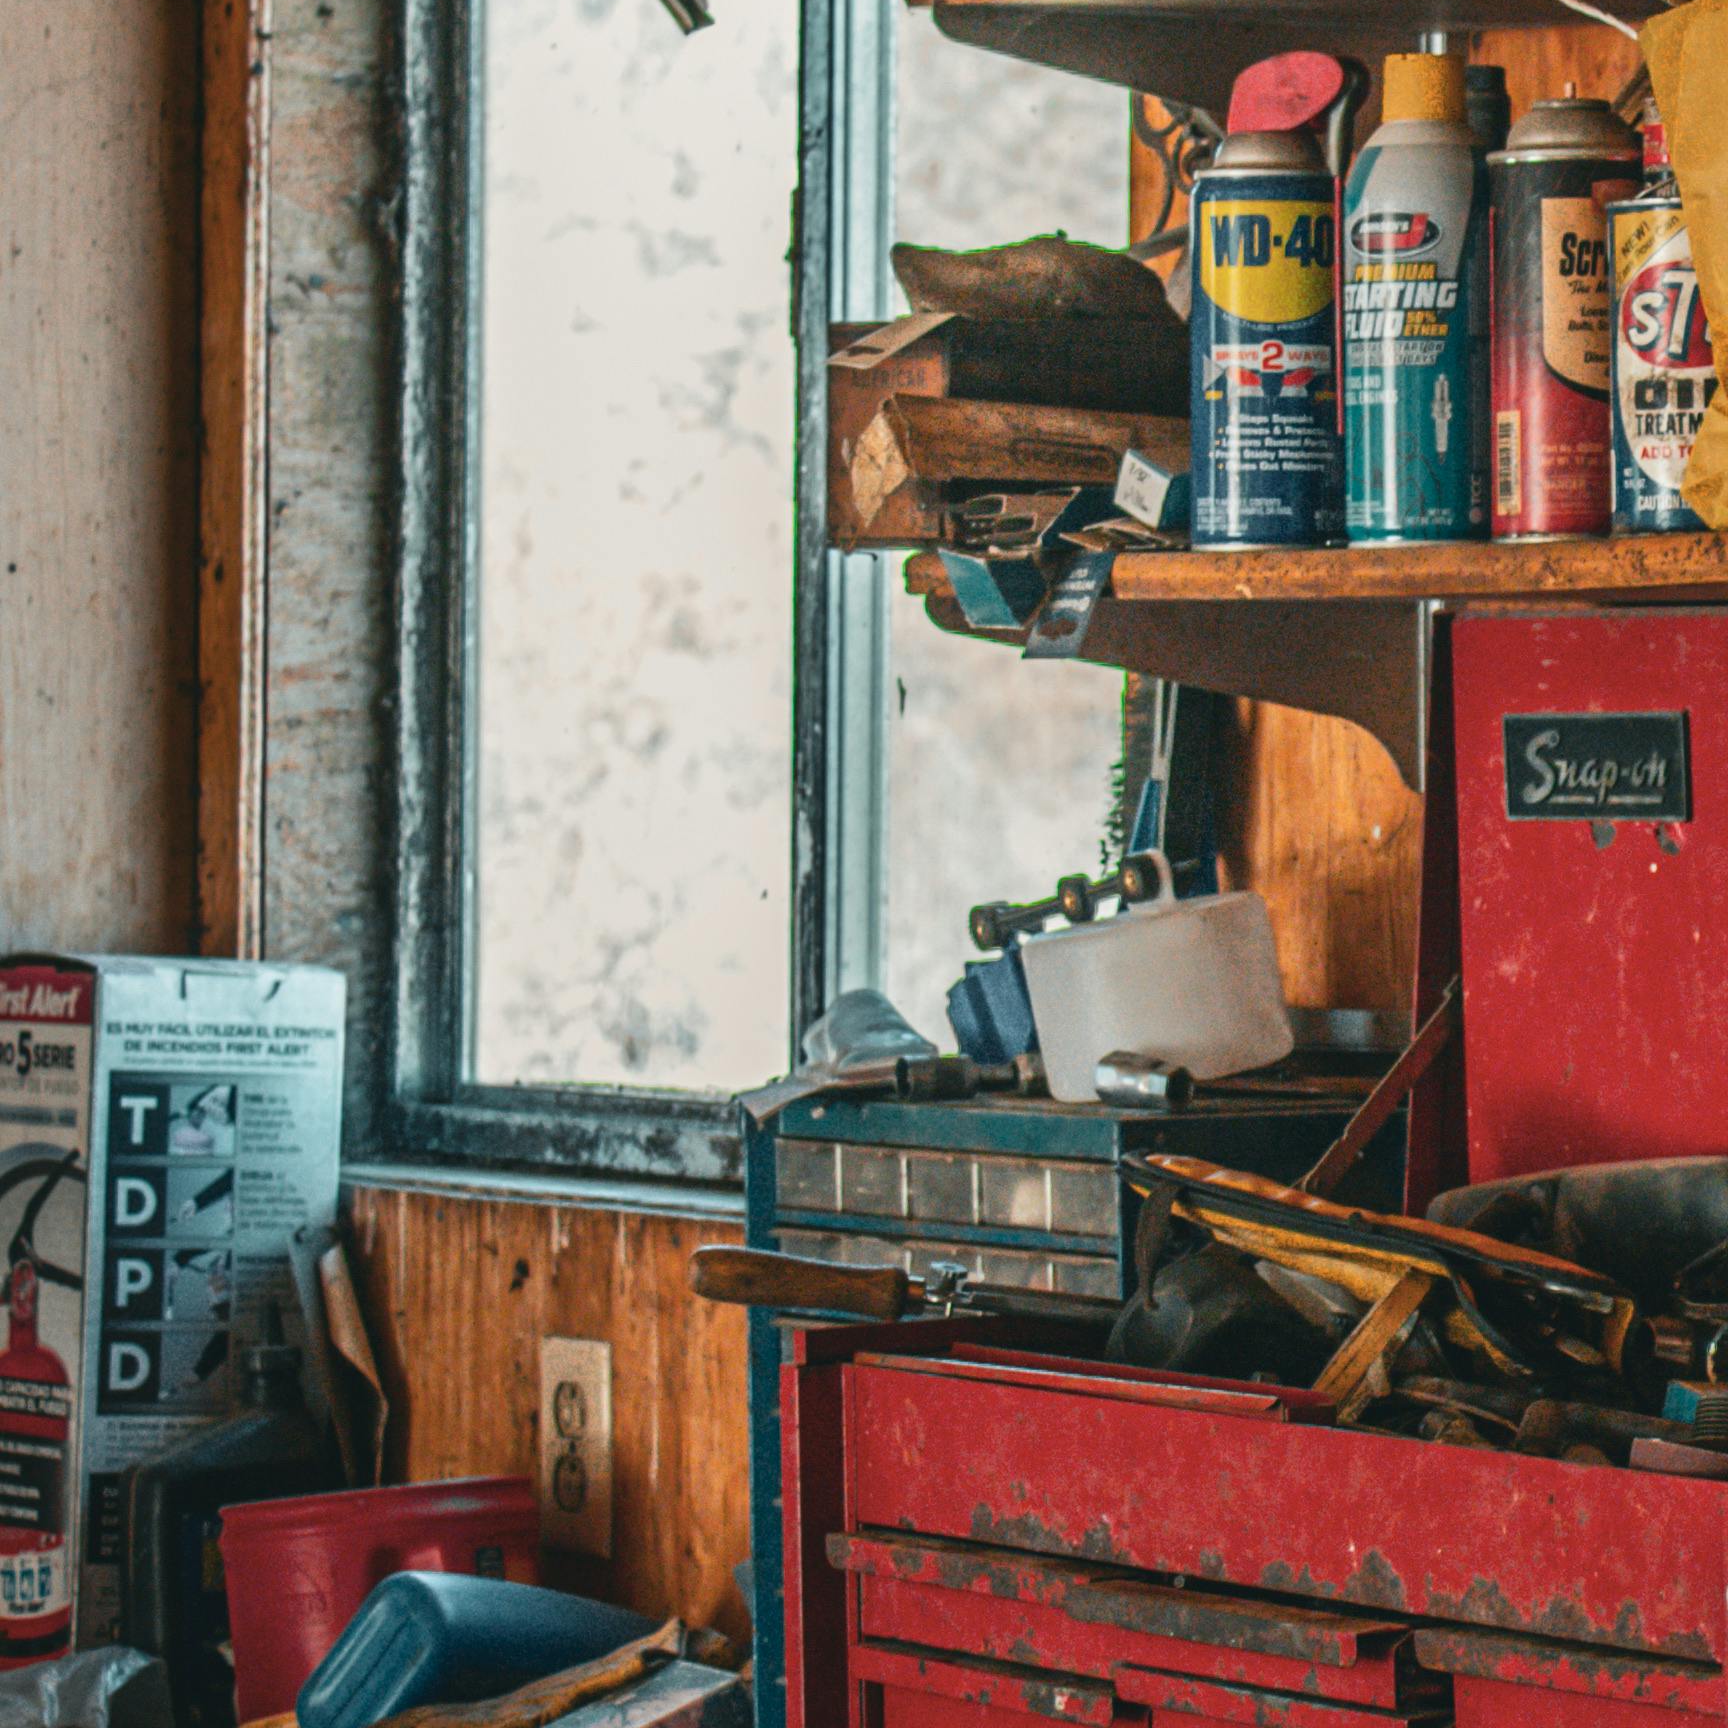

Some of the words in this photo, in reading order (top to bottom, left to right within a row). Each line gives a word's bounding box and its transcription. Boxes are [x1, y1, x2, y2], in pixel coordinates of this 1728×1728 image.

[1355, 261, 1438, 282] PREMIUM
[1345, 308, 1408, 339] FLUID
[1403, 323, 1449, 337] ETHER
[1628, 266, 1713, 361] ST
[1260, 340, 1285, 371] 2
[1288, 349, 1330, 362] WAYS
[1640, 445, 1672, 460] ADD
[1522, 729, 1667, 805] Snap-on
[29, 983, 83, 1019] Alert
[123, 1041, 143, 1053] DE
[147, 1041, 222, 1054] INCENDIOS
[226, 1042, 263, 1055] FIRST
[267, 1043, 310, 1056] ALERT
[125, 1023, 155, 1036] MUY
[196, 1025, 252, 1037] UTILIZAR
[256, 1026, 270, 1038] EL
[16, 1029, 33, 1078] 5
[33, 1043, 76, 1071] SERIE
[119, 1095, 158, 1146] T
[113, 1176, 158, 1227] D
[115, 1256, 154, 1309] P
[108, 1341, 151, 1392] D
